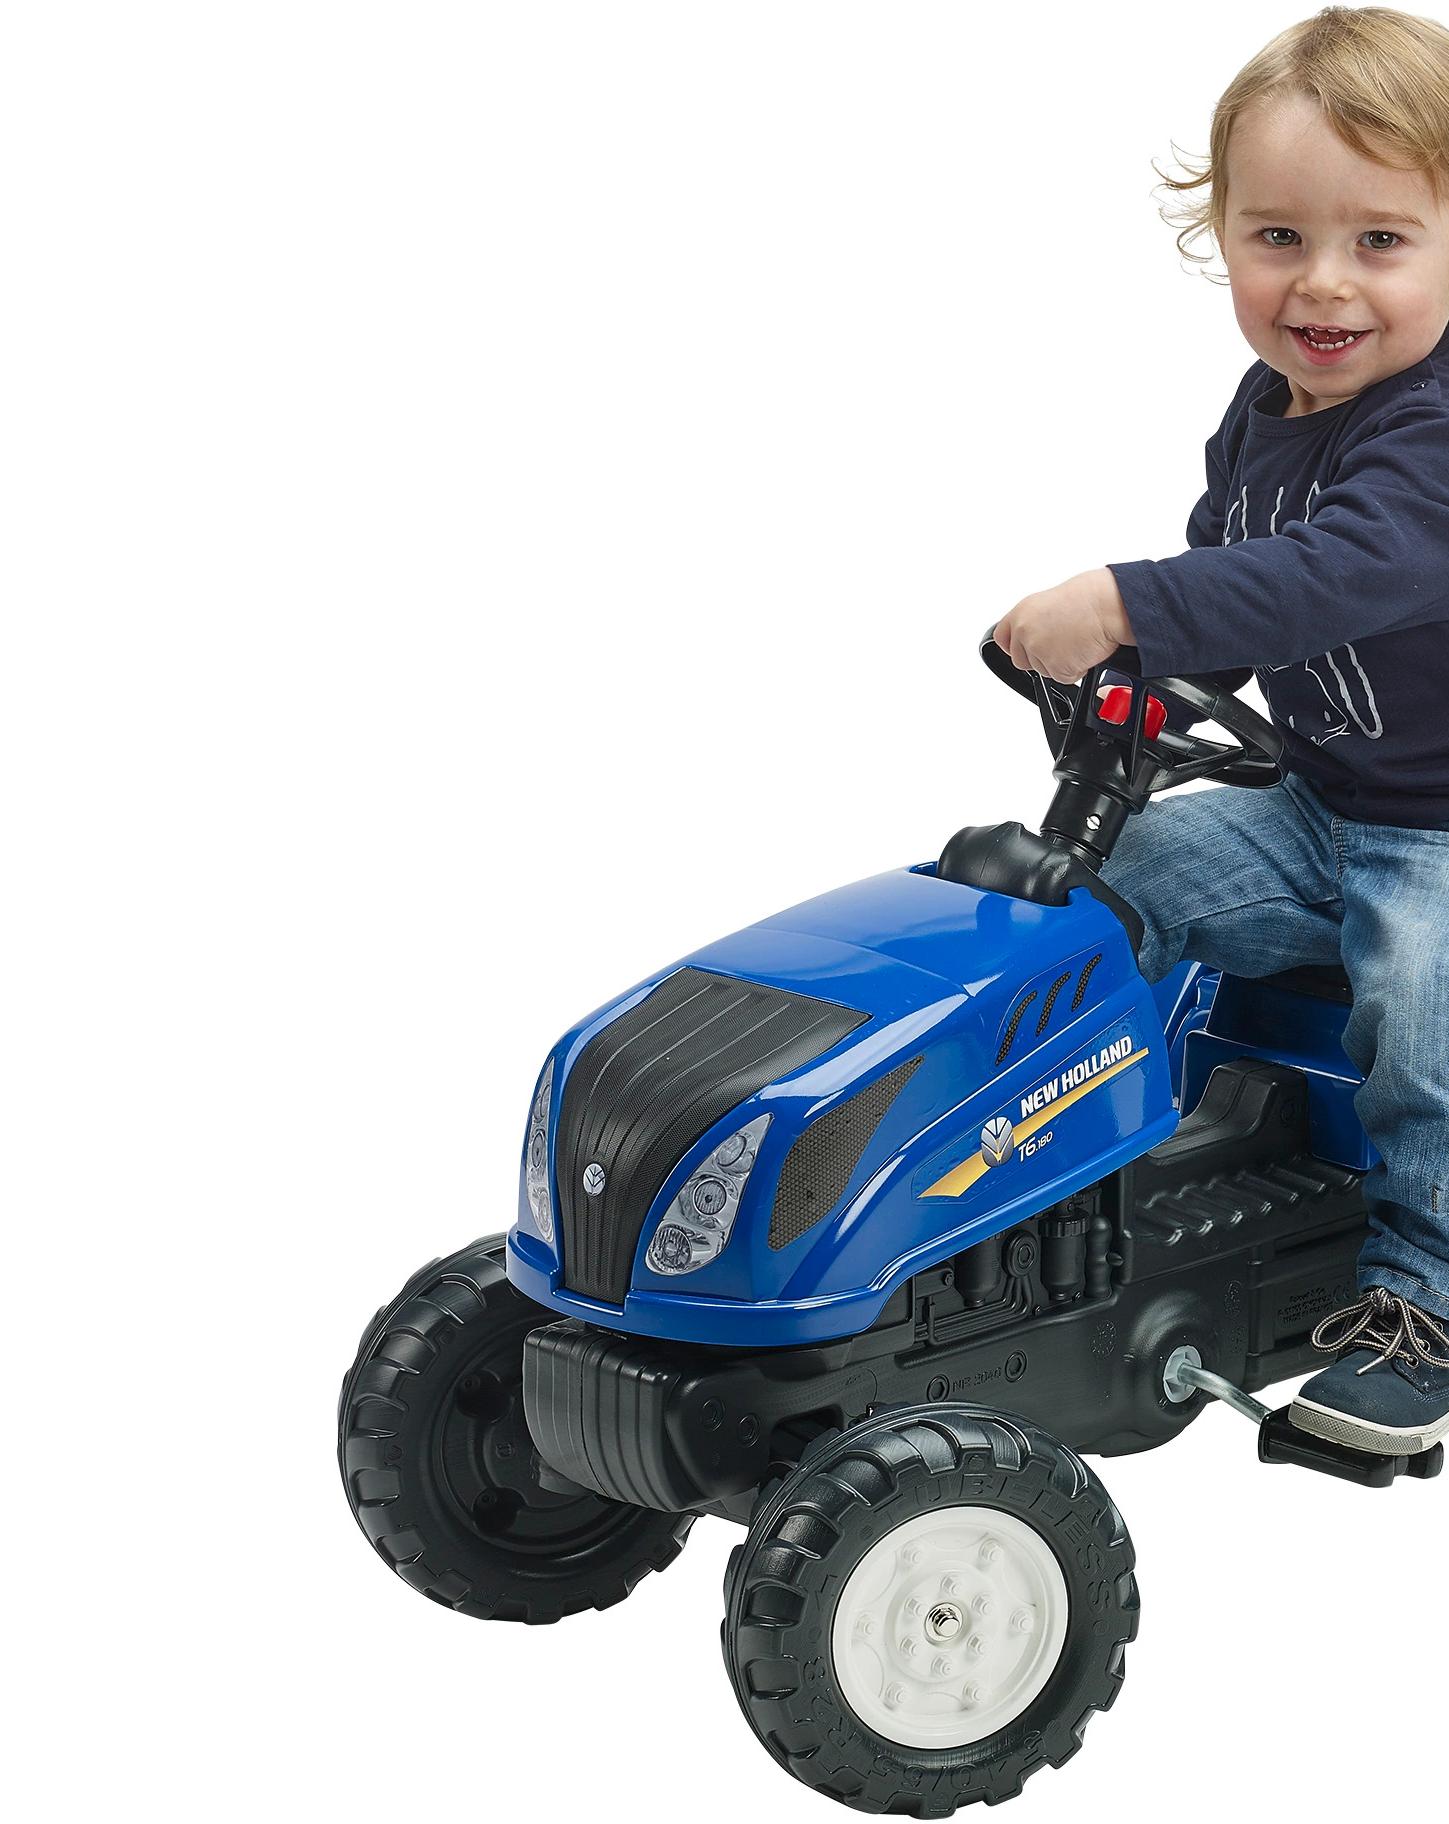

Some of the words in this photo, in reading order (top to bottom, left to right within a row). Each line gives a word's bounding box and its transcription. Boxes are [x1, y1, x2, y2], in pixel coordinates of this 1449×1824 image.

[1020, 1078, 1059, 1118] NEW
[1061, 1034, 1133, 1093] HOLLAND
[1018, 1131, 1053, 1162] T6.180
